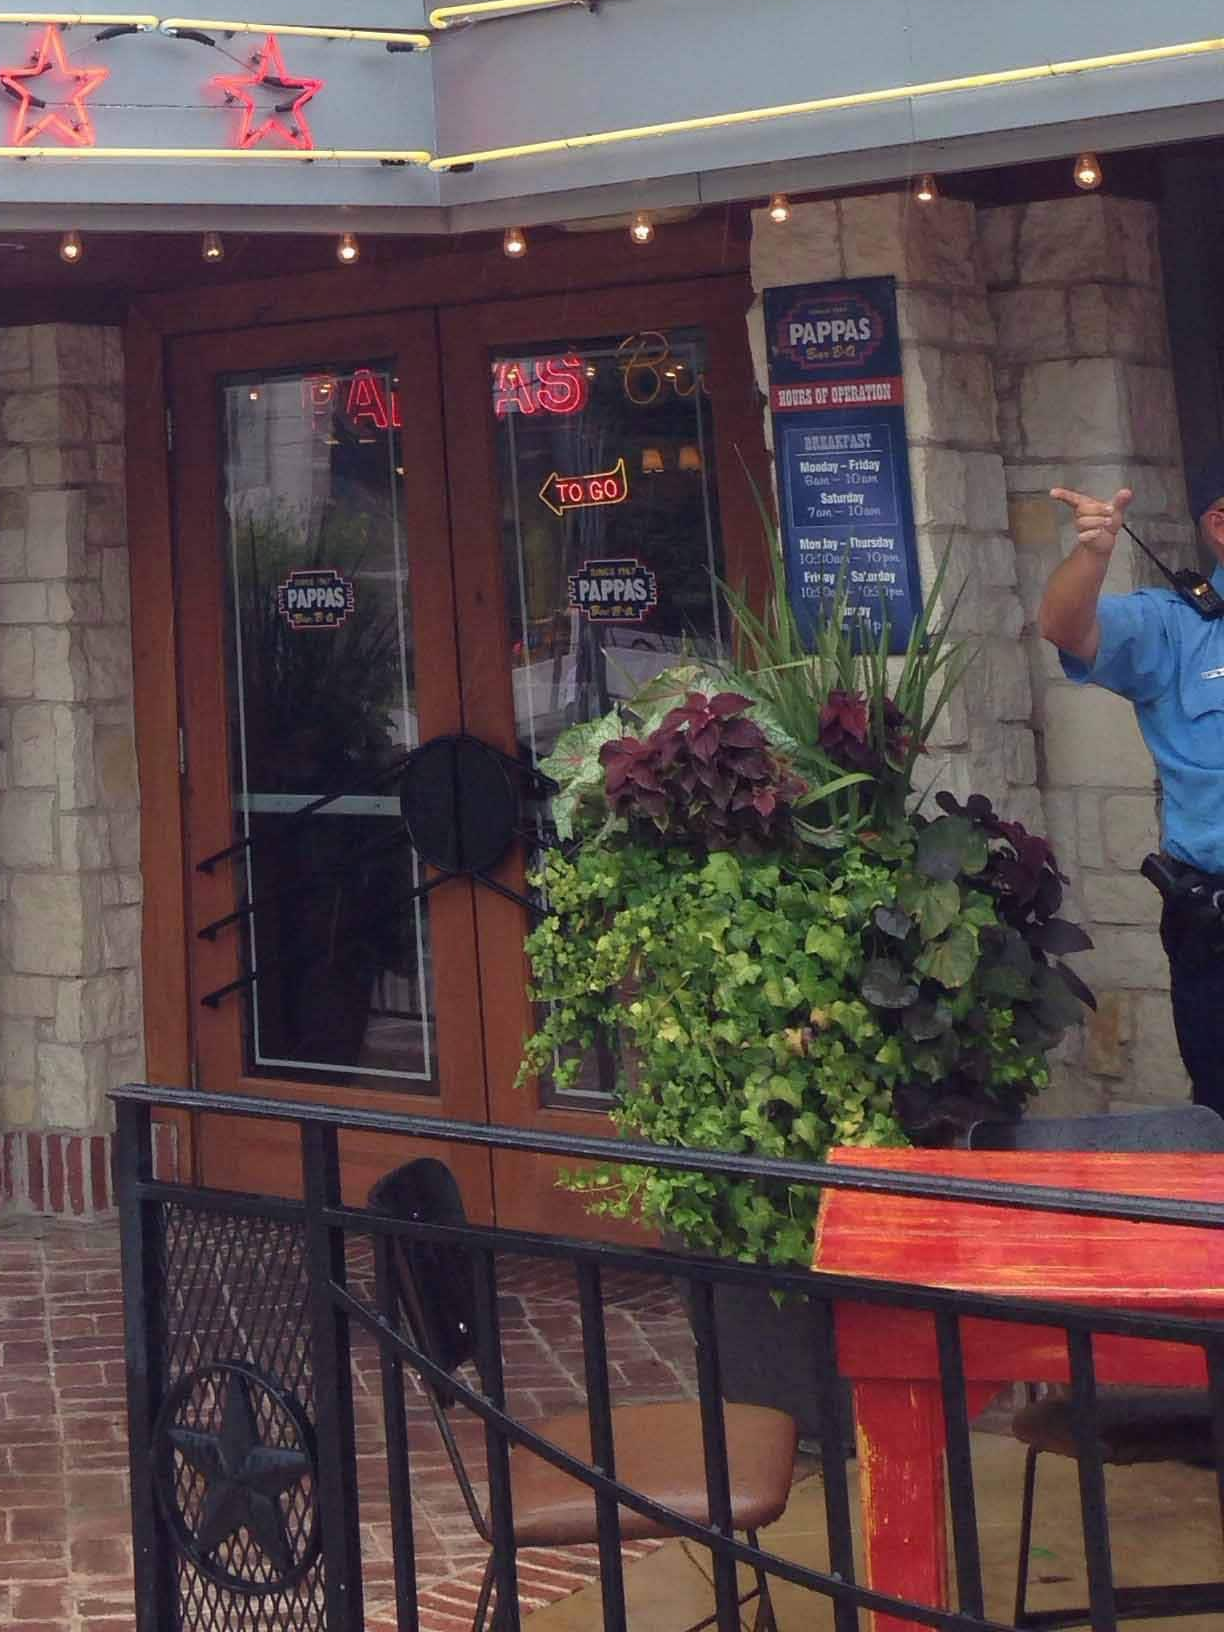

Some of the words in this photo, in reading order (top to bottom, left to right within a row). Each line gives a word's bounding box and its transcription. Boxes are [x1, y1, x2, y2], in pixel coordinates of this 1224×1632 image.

[789, 317, 872, 346] PAPPAS
[778, 388, 813, 407] HOURS
[815, 387, 829, 405] OF
[831, 383, 892, 404] OPERATION
[803, 432, 872, 451] BREAKFAST
[799, 460, 839, 474] Monday
[848, 458, 881, 473] Friday
[555, 482, 584, 504] TO
[588, 478, 619, 502] GO
[820, 492, 865, 505] Saturday
[287, 587, 345, 609] PAPPAS
[578, 578, 648, 601] PAPPAS
